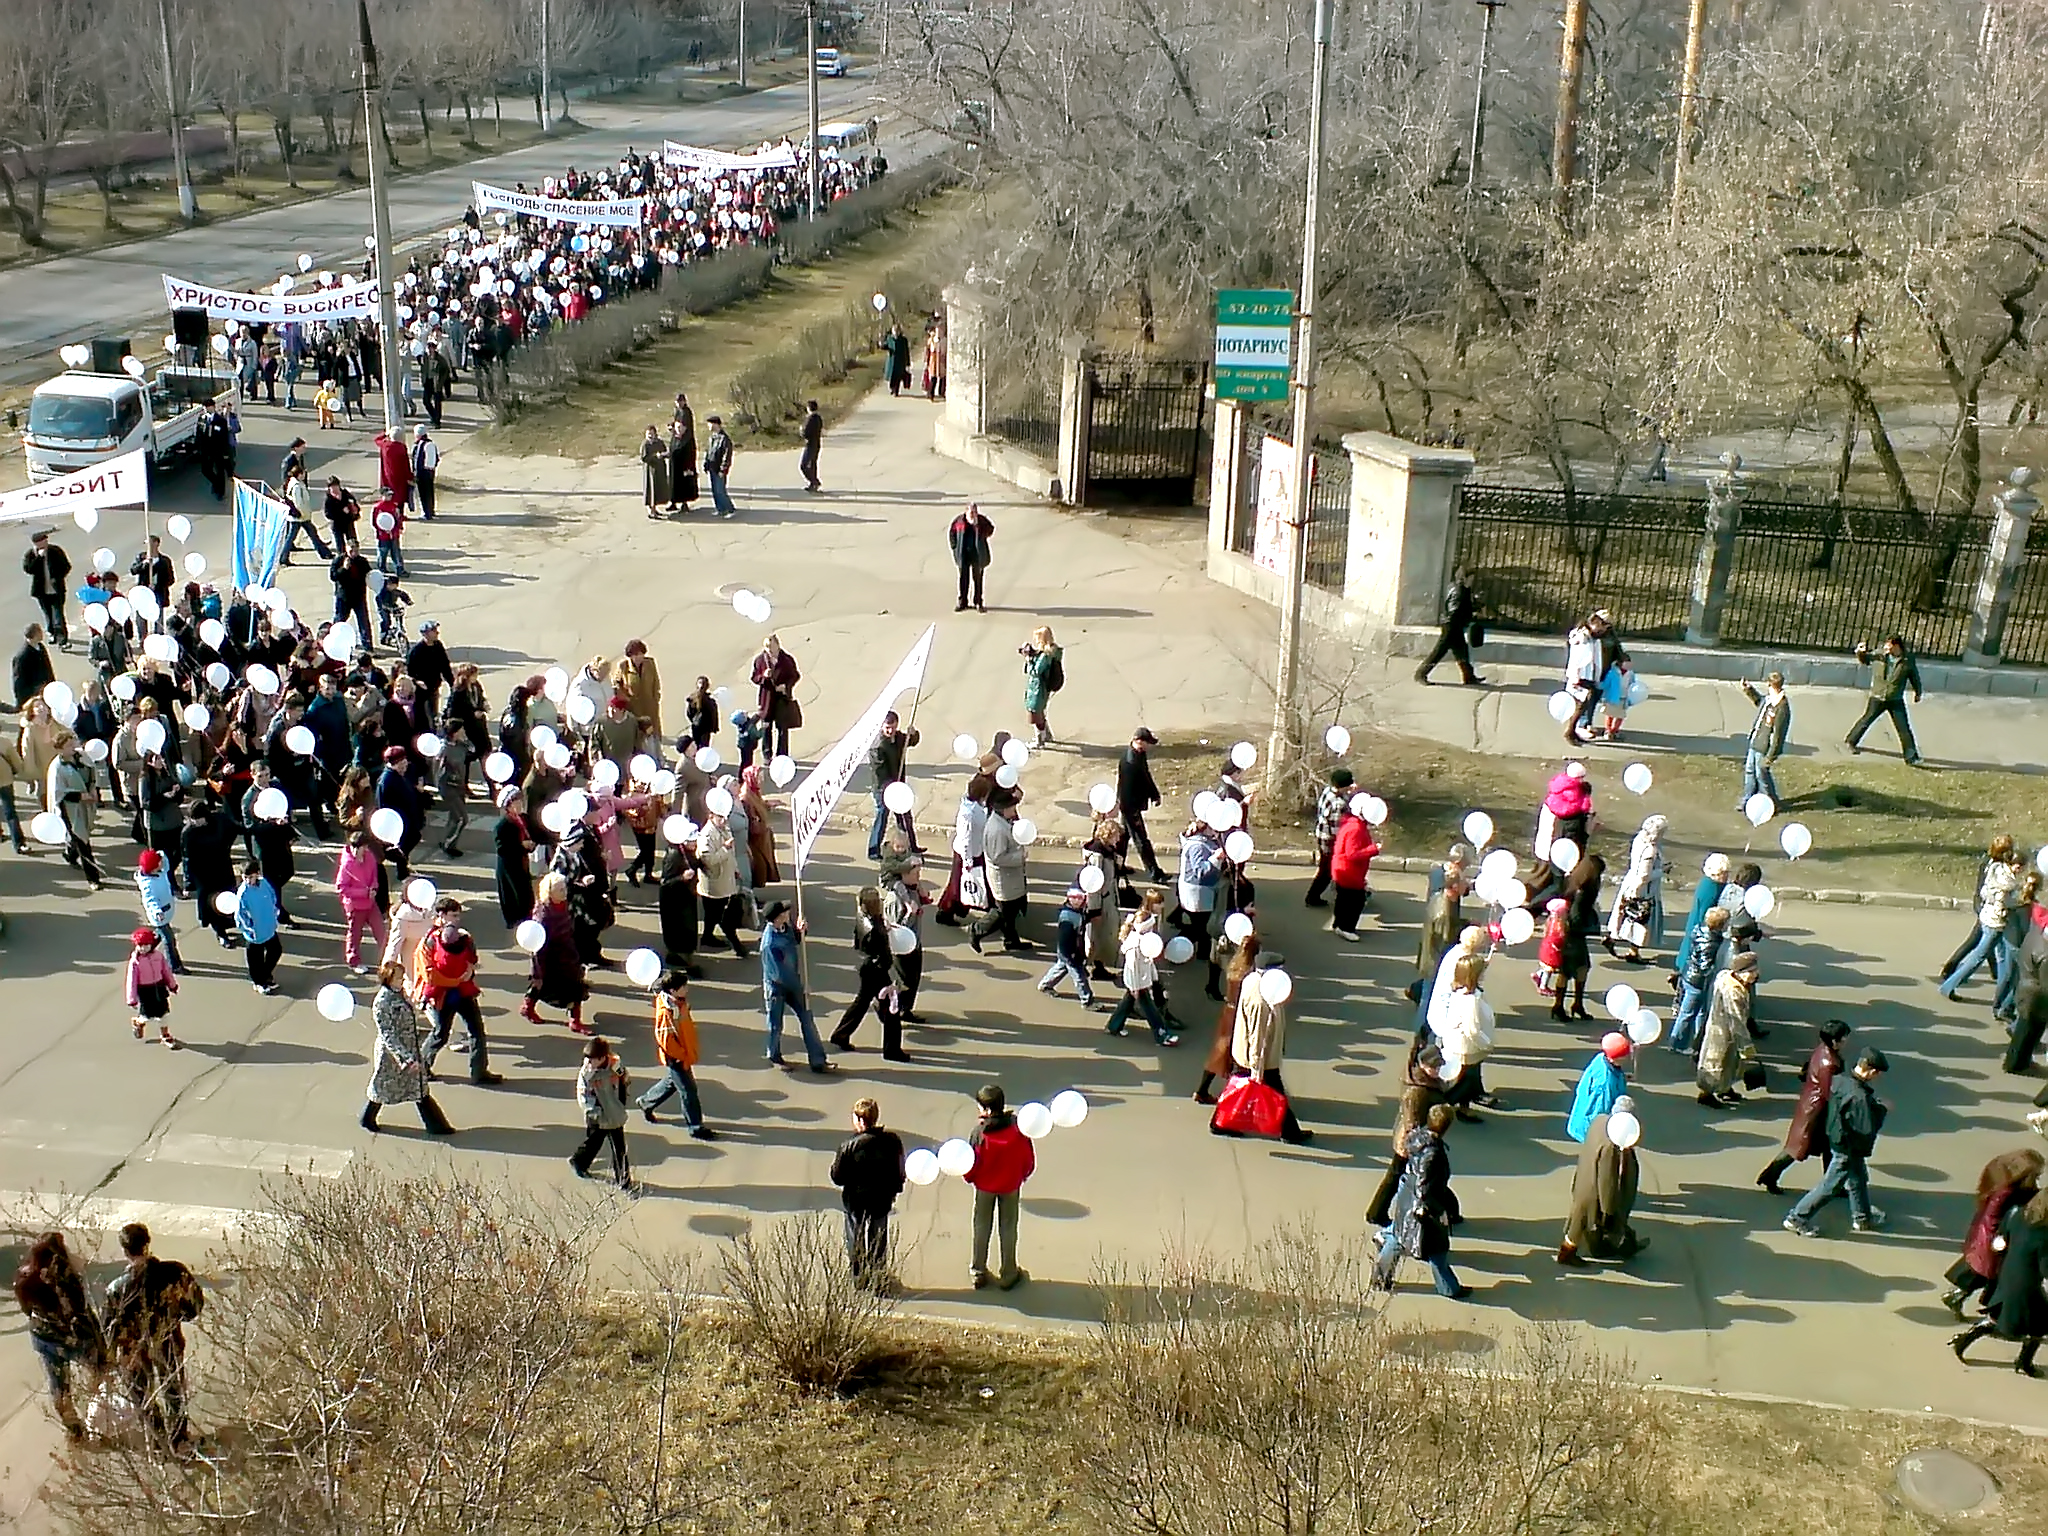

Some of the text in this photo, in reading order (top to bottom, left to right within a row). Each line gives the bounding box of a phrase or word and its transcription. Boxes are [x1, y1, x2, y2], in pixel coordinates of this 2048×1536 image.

[544, 203, 605, 216] СПАСЕНИЕ
[609, 206, 634, 216] МОЕ
[171, 284, 380, 315] ХРИСТОС ВОСКРЕС
[1217, 338, 1289, 355] НОТАРИУС
